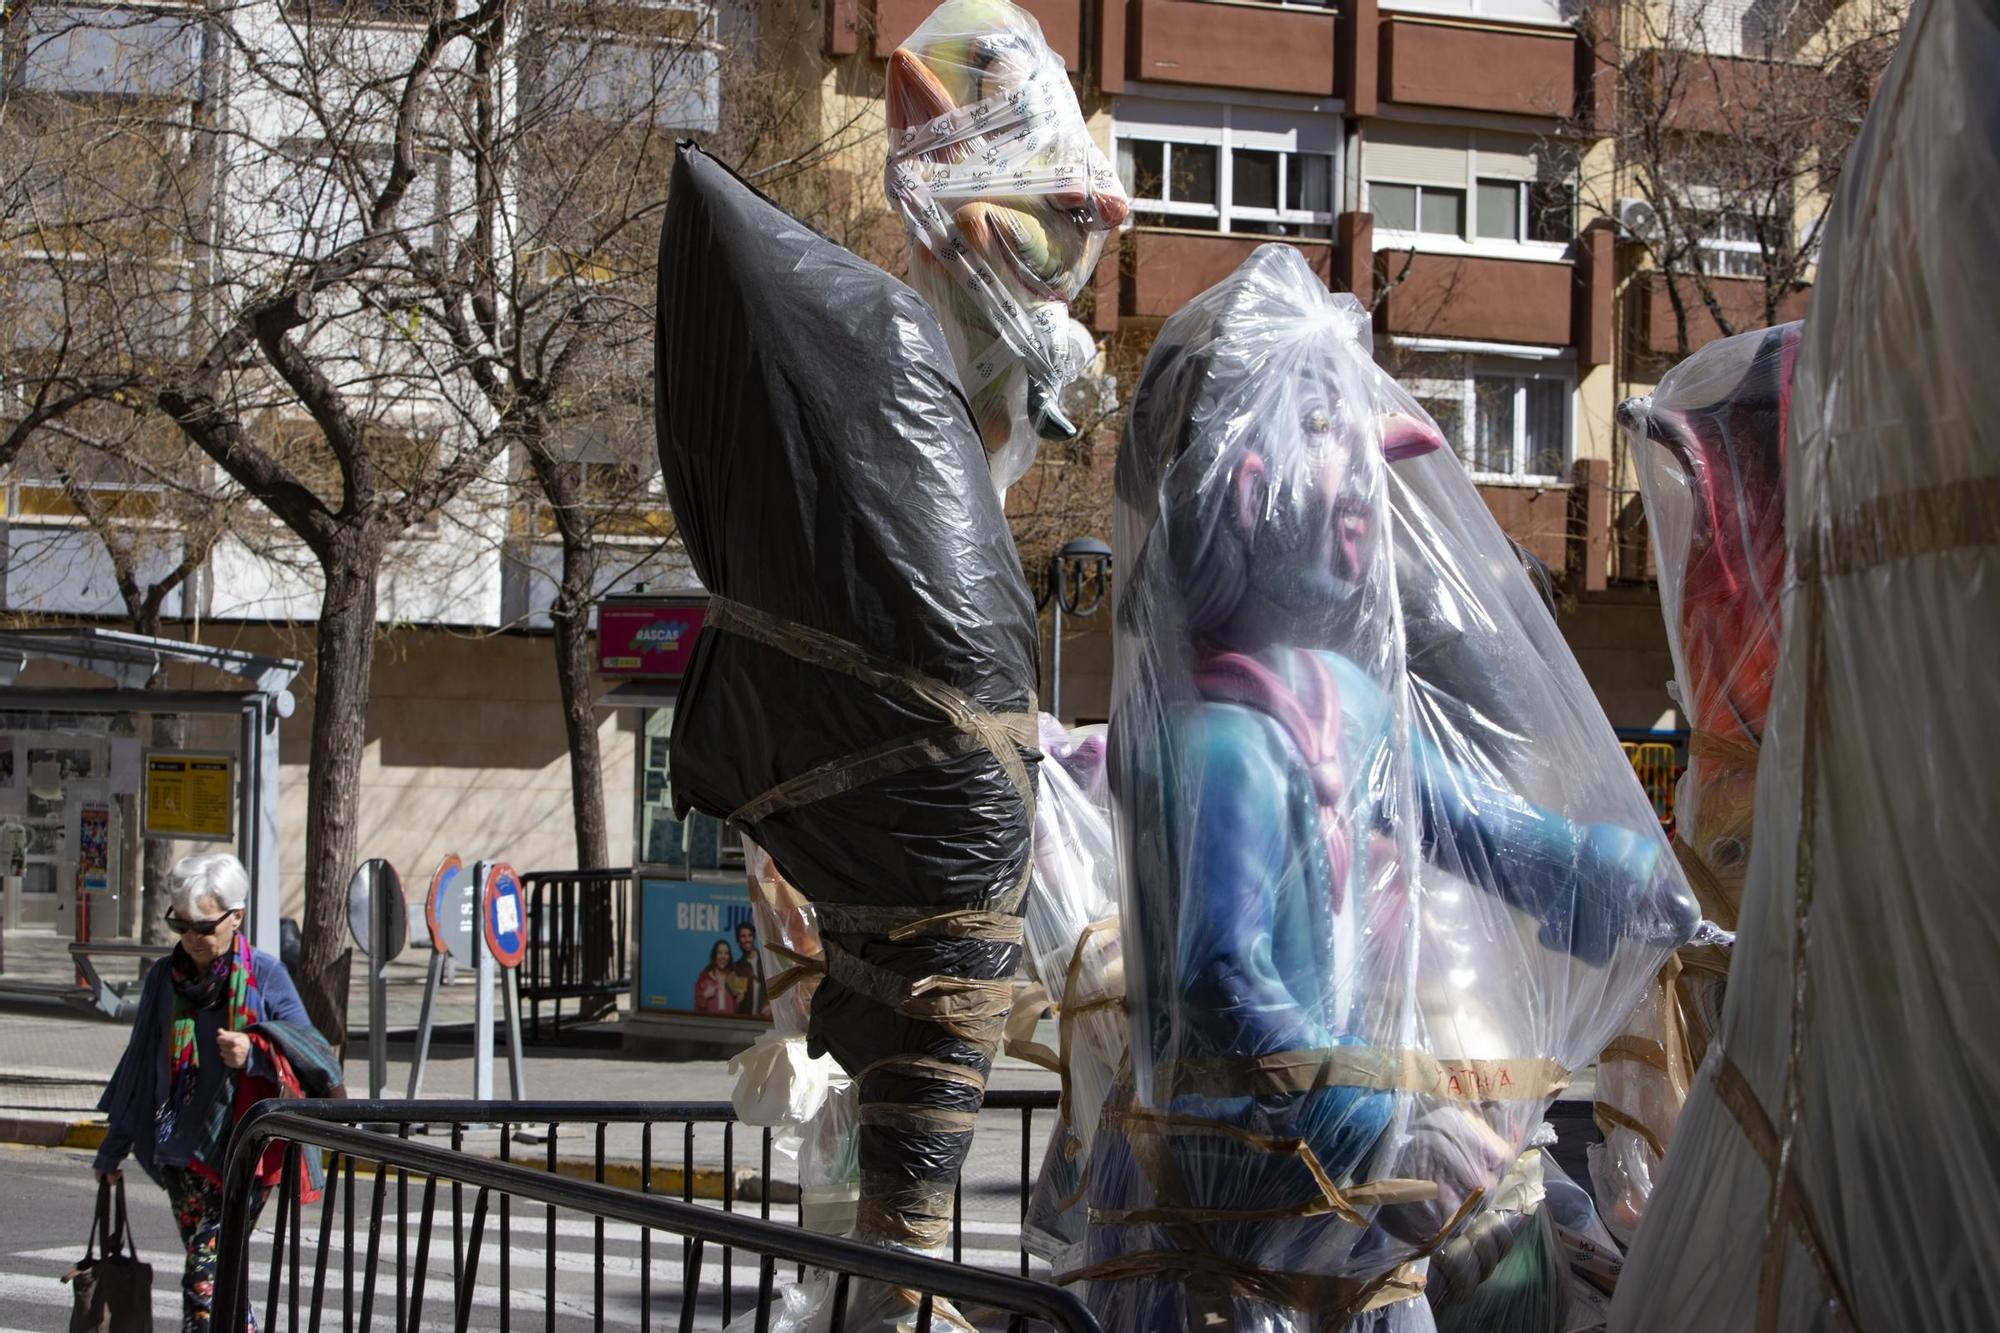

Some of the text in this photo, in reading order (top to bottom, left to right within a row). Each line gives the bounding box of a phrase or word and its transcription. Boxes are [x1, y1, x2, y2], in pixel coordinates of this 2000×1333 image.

[636, 630, 680, 641] RASCAS
[677, 902, 752, 932] BIEN JU
